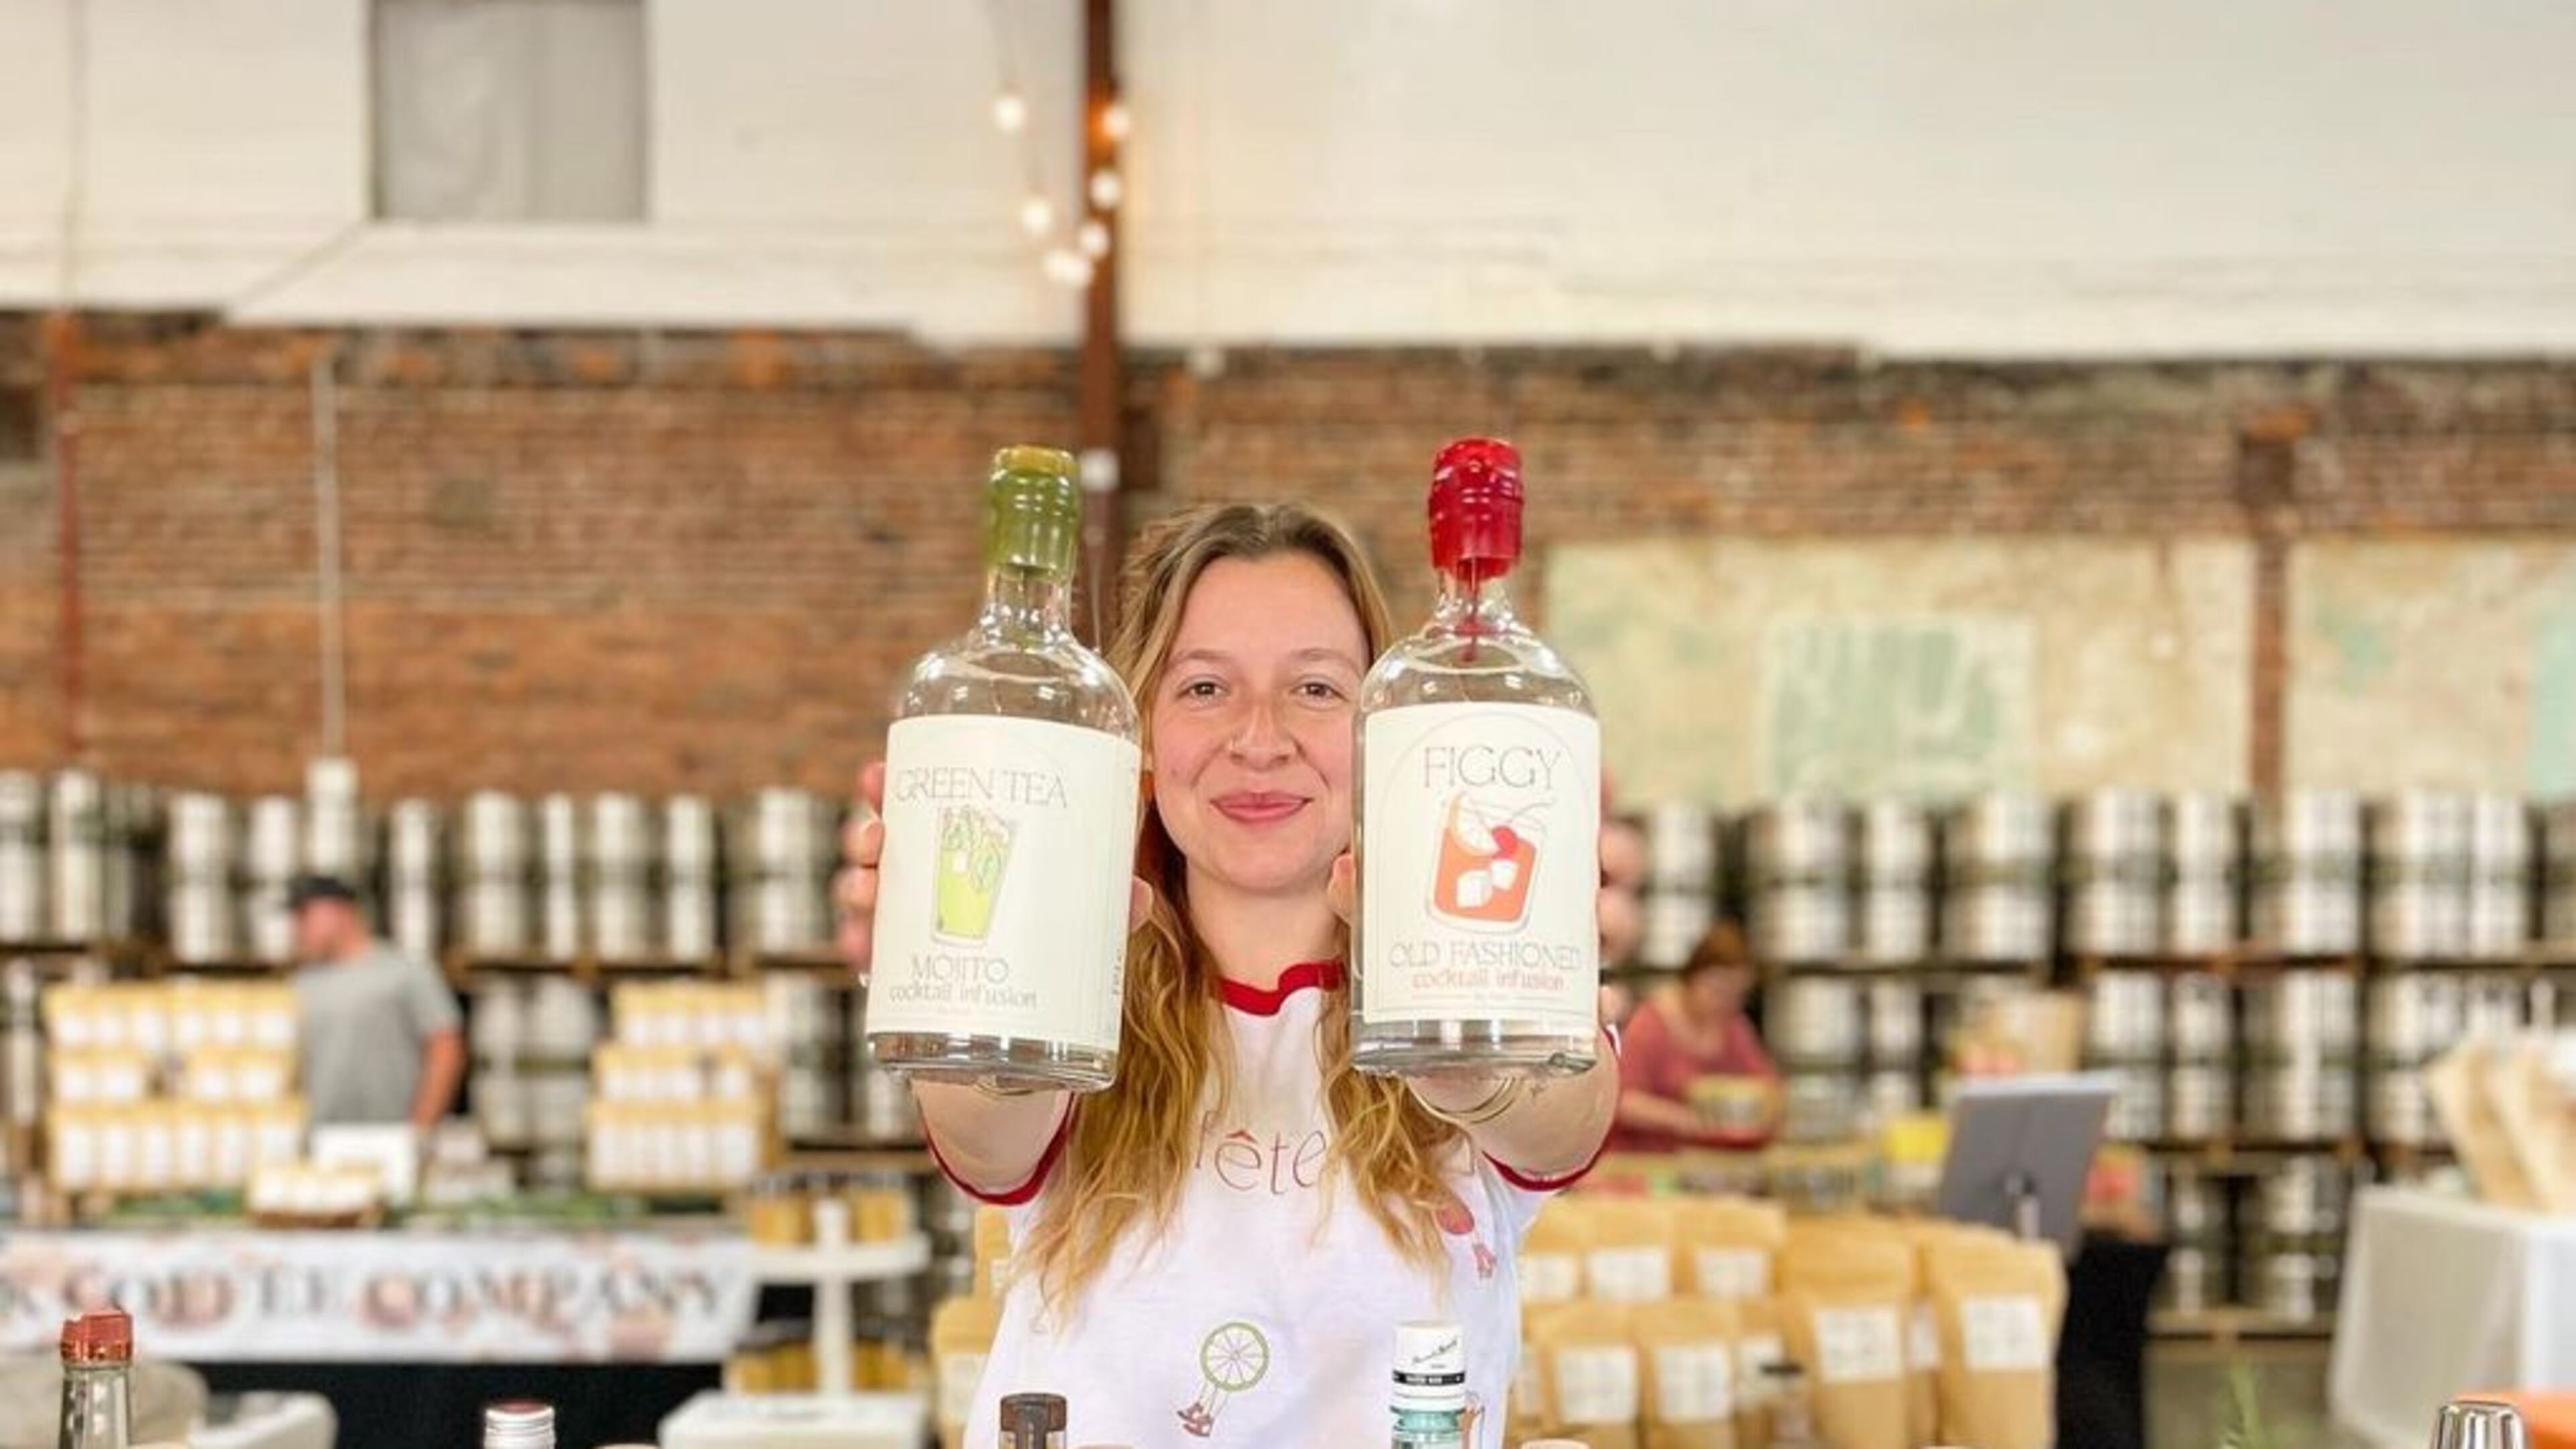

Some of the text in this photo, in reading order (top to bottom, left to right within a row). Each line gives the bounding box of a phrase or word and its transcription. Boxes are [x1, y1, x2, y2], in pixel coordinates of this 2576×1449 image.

[1424, 743, 1562, 790] FIGGY
[894, 766, 1068, 809] GREEN TEA
[911, 953, 1009, 984] MOJITO
[1390, 940, 1580, 970] OLD FASHIONED
[890, 981, 1037, 1009] cocktail infusion
[1411, 969, 1564, 991] cocktail infusion
[1195, 1110, 1327, 1195] fête
